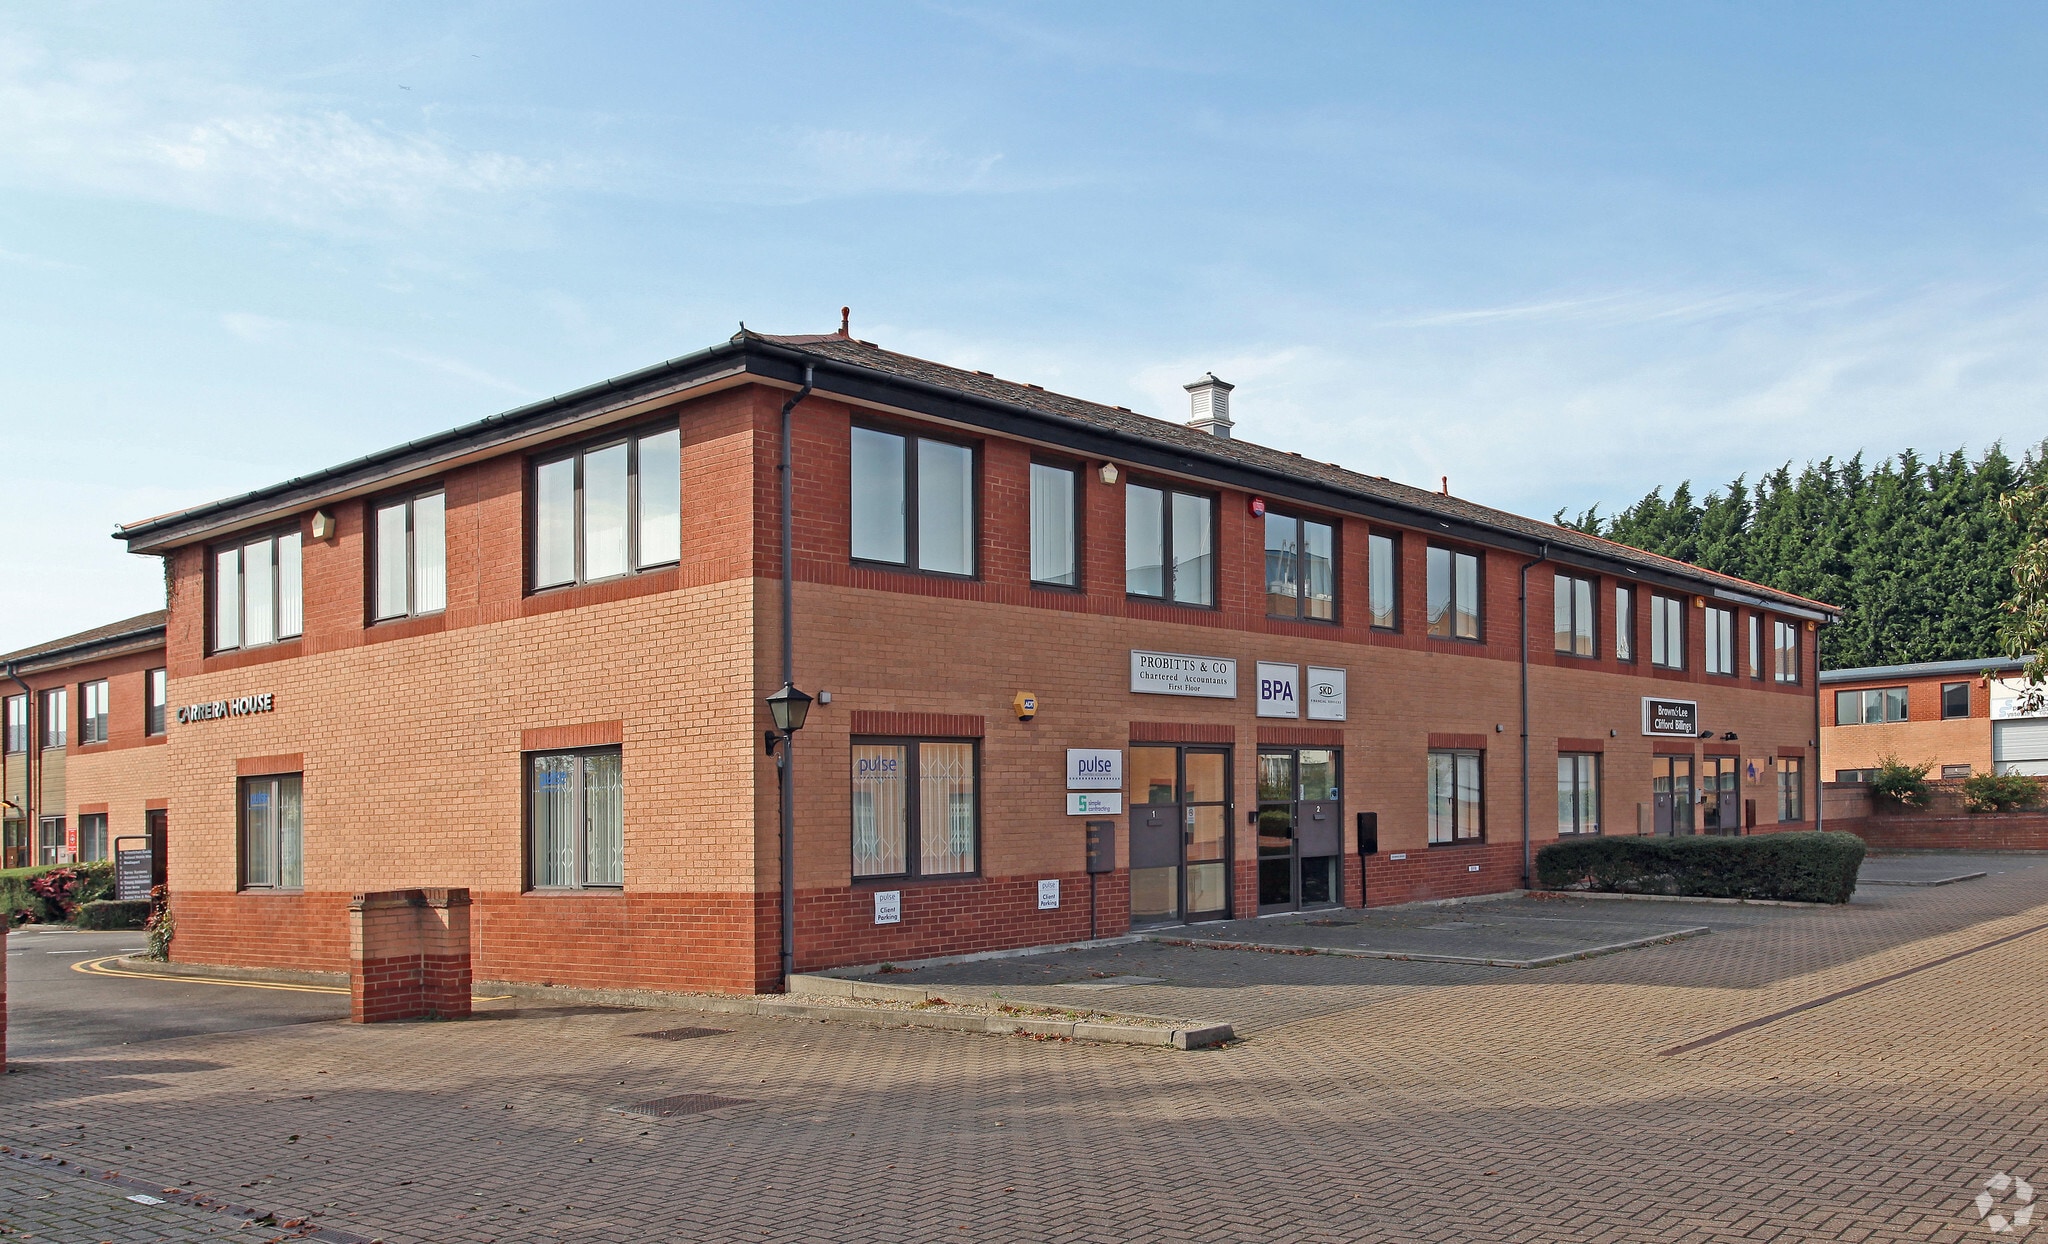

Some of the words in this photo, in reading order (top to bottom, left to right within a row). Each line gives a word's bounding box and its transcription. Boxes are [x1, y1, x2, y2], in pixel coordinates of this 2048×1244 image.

[1140, 656, 1195, 671] PROBITTS
[1200, 662, 1208, 672] &
[1212, 663, 1227, 674] CO
[1140, 671, 1178, 681] Chartered
[1184, 675, 1227, 685] Accountants
[1168, 683, 1183, 691] First
[1185, 684, 1201, 692] Floor
[1261, 680, 1294, 701] BPA
[1319, 686, 1333, 695] SKD
[176, 700, 231, 722] CARRERA
[231, 693, 273, 715] HOUSE
[860, 756, 897, 775] pulse
[1079, 756, 1111, 776] pulse
[880, 894, 896, 902] pulse
